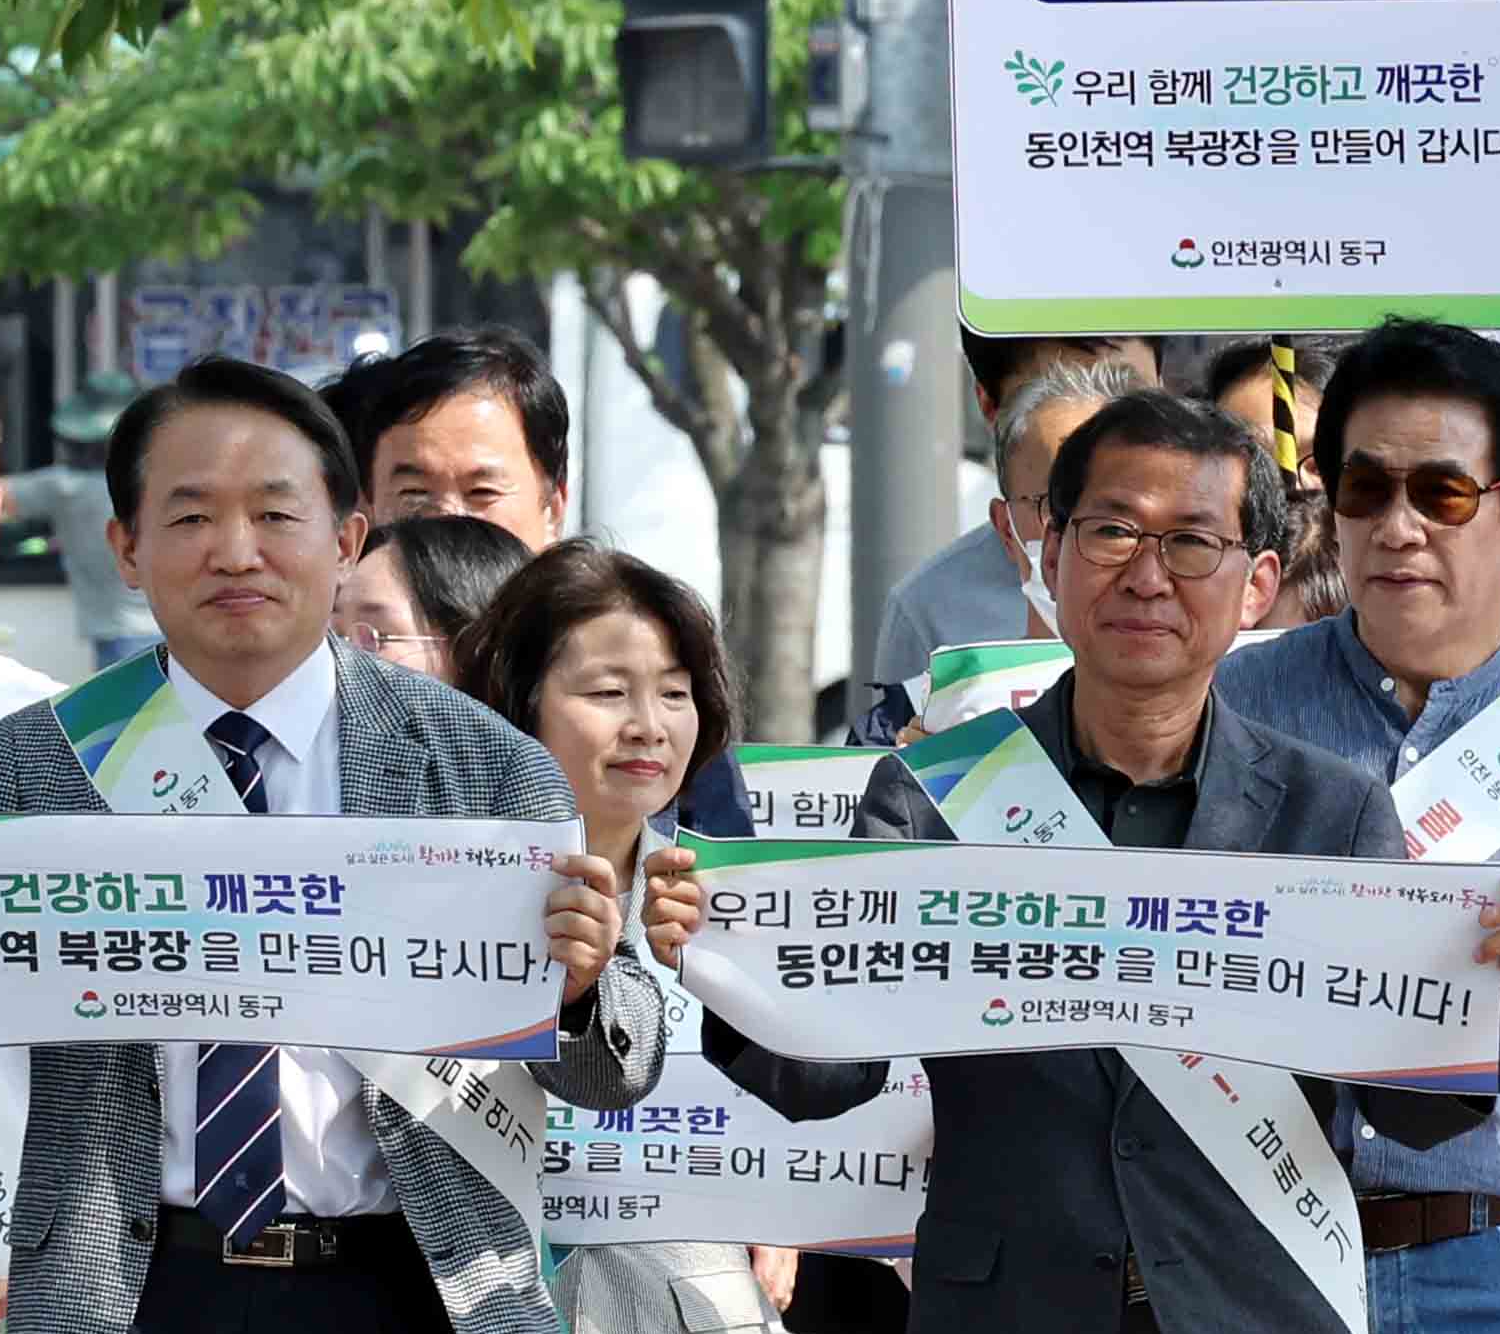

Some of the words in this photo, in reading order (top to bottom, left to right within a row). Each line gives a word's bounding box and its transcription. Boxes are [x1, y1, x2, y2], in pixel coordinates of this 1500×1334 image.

[1073, 70, 1136, 106] 우리
[1148, 68, 1212, 106] 함께
[1223, 64, 1366, 106] 건강하고
[1375, 62, 1484, 104] 깨끗한
[1025, 130, 1154, 169] 동인천역
[1310, 127, 1405, 167] 만들어
[1211, 239, 1332, 267] 인천광역시
[1340, 238, 1387, 265] 동구
[0, 873, 188, 914] 건강하고
[205, 873, 346, 915] 깨끗한
[709, 889, 791, 930] 우리
[812, 888, 897, 929] 함께
[917, 892, 1107, 931] 건강하고
[1126, 896, 1270, 939] 깨끗한
[260, 932, 388, 978] 만들어
[406, 935, 552, 985] 갑시다!
[113, 991, 230, 1018] 인천광역시
[238, 990, 284, 1019] 동구
[776, 940, 950, 987] 동인천역
[1175, 945, 1311, 994] 만들어
[1325, 963, 1472, 1028] 갑시다!
[1020, 999, 1139, 1024] 인천광역시
[1147, 1000, 1195, 1028] 동구
[643, 1143, 765, 1179] 만들어
[618, 1195, 662, 1220] 동구
